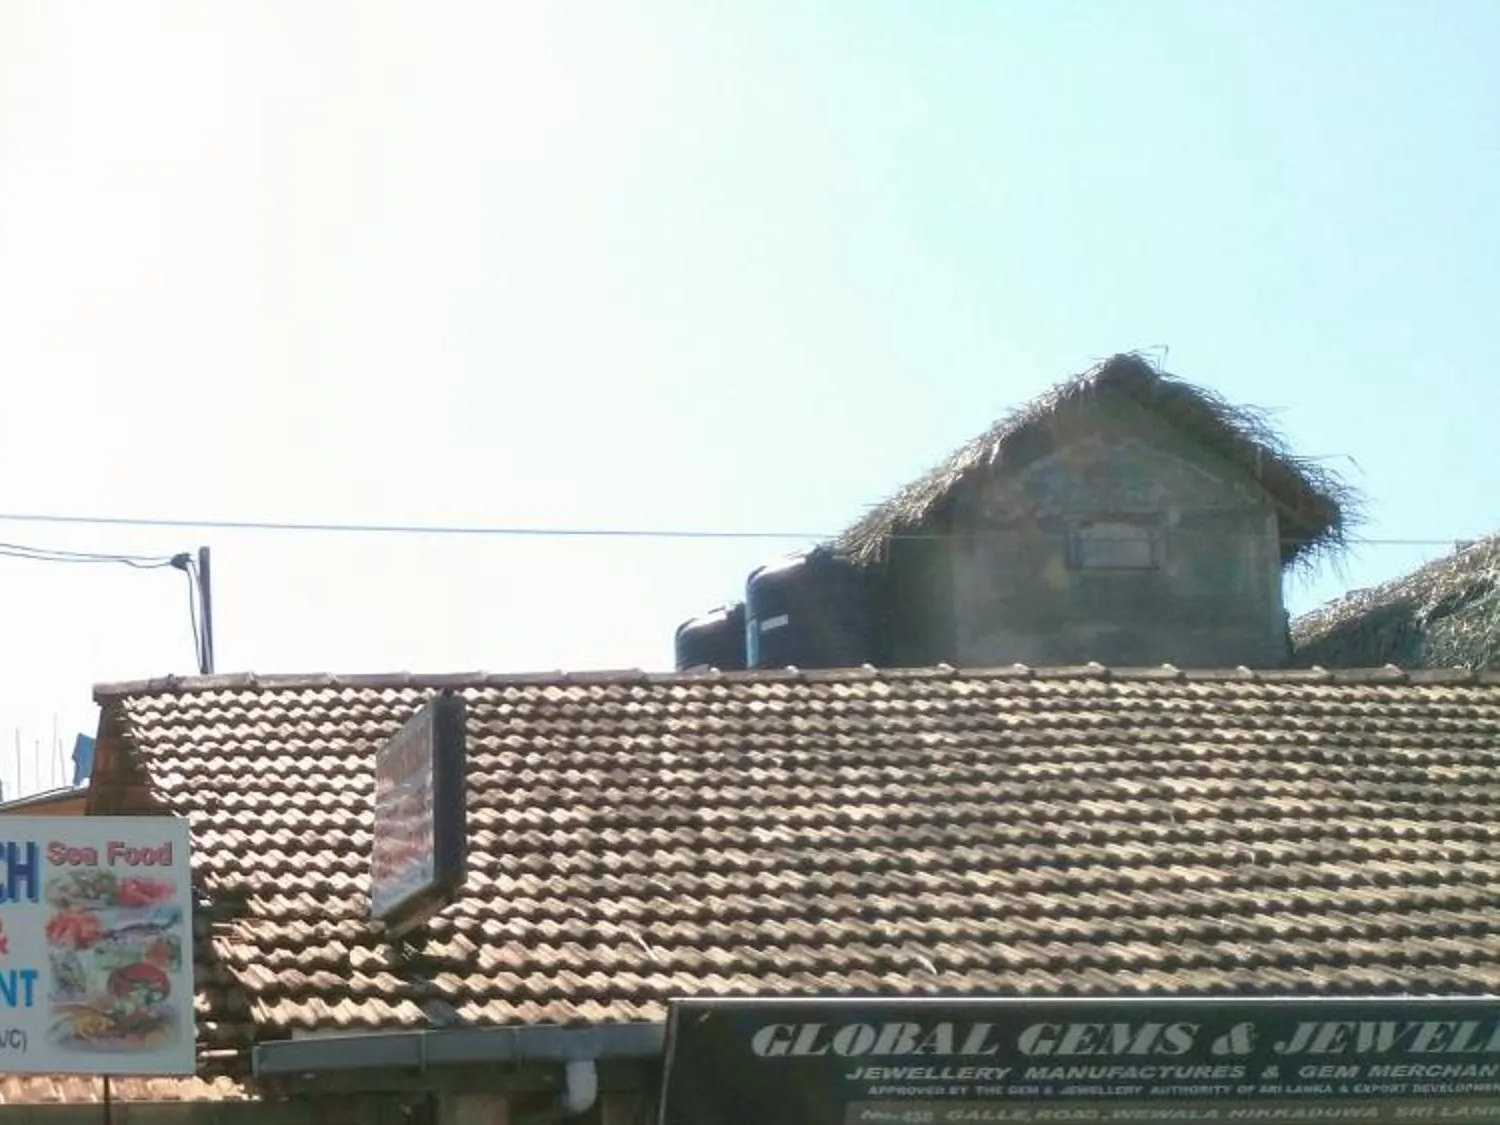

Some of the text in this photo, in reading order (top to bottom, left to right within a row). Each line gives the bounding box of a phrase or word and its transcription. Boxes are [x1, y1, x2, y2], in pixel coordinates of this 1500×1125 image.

[46, 841, 173, 866] Sea Food
[750, 1021, 1002, 1058] GLOBAL
[1017, 1021, 1203, 1057] GEMS
[1211, 1020, 1260, 1057] &
[844, 1065, 1013, 1081] JEWELLERY
[1024, 1064, 1247, 1080] MANUFACTURES
[1261, 1064, 1280, 1079] &
[1298, 1063, 1361, 1079] GEM
[975, 1084, 1003, 1096] THE
[1149, 1084, 1233, 1096] AUTHORITY
